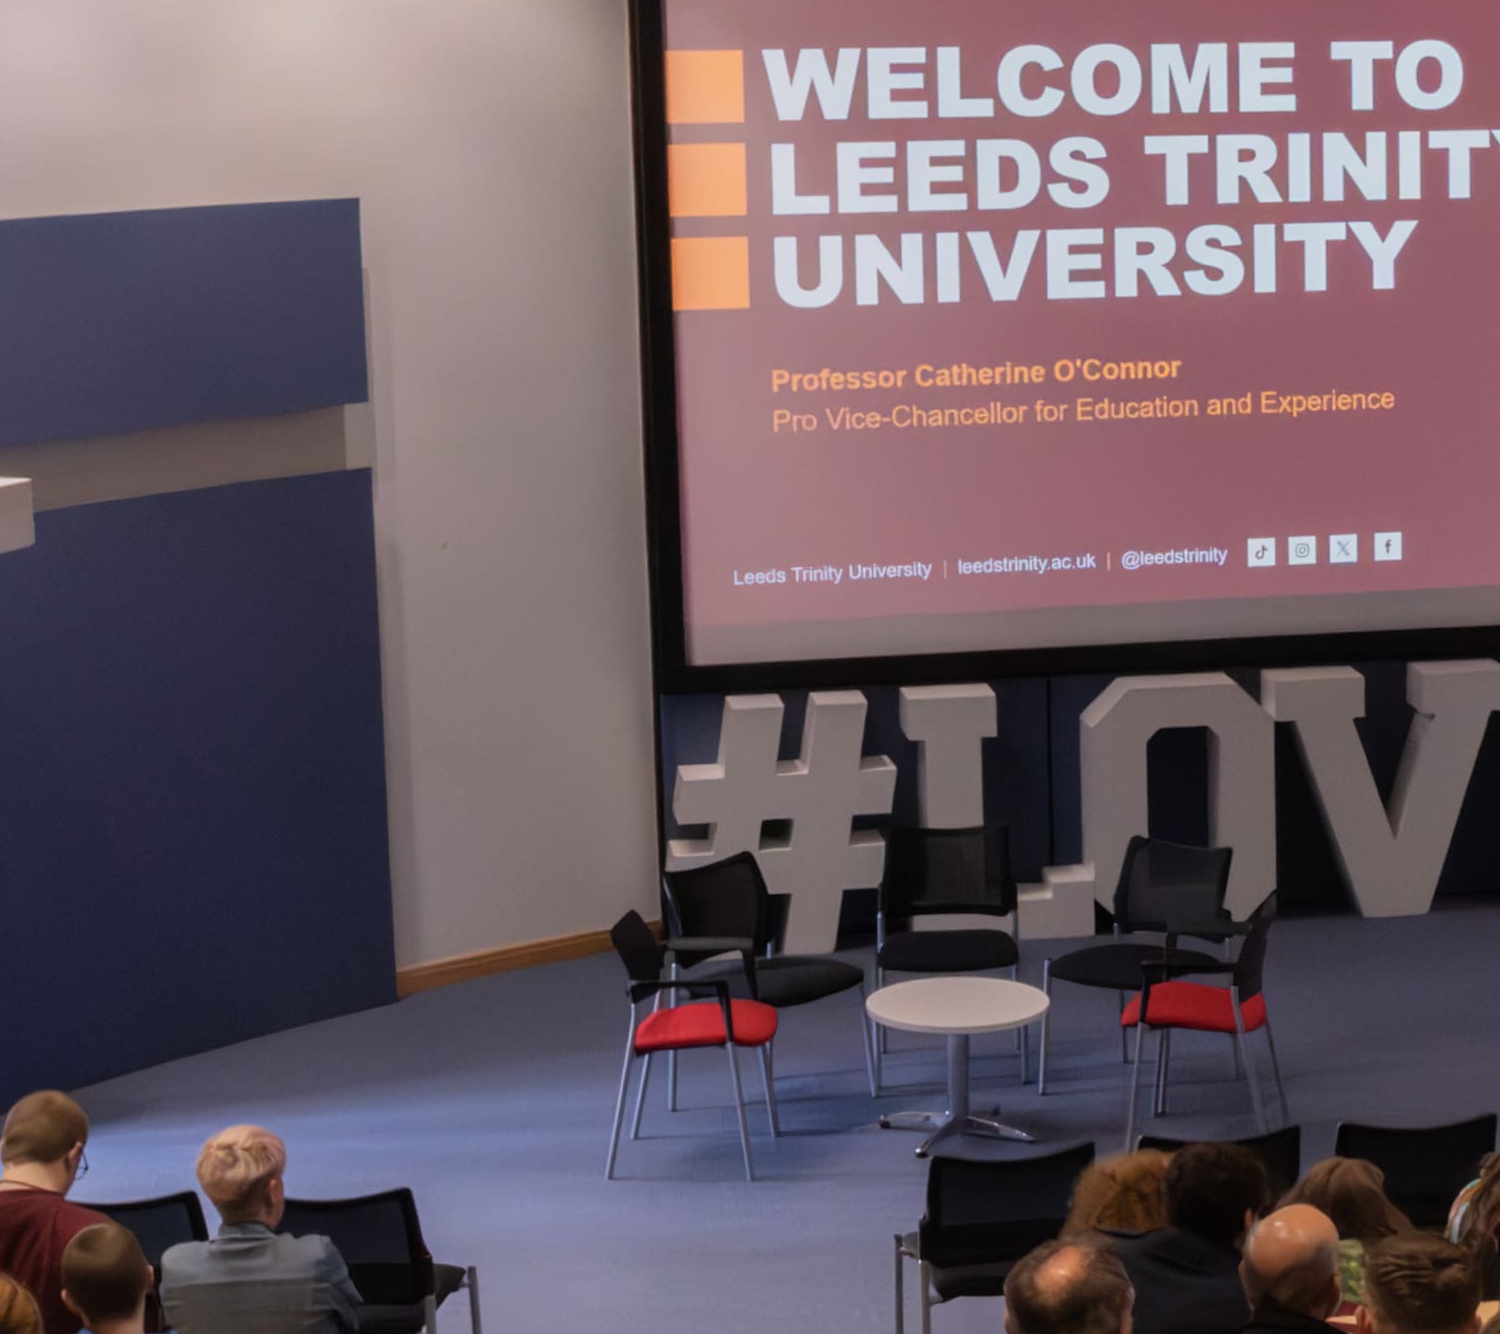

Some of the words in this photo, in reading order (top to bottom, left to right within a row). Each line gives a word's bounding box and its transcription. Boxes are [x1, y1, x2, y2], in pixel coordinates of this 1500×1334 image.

[761, 42, 1297, 122] WELCOME
[1330, 40, 1464, 111] TO
[771, 136, 1111, 216] LEEDS
[773, 220, 1419, 309] UNIVERSITY
[772, 367, 907, 393] Professor
[915, 361, 1046, 388] Catherine
[1054, 359, 1182, 383] O'Connor
[773, 409, 818, 433] Pro
[825, 400, 1028, 431] Vice-Chancellor
[1034, 400, 1068, 422] for
[1076, 396, 1199, 421] Education
[1207, 392, 1252, 416] and
[1260, 389, 1396, 418] Experience
[733, 569, 787, 586] Leeds
[791, 565, 843, 585] Trinity
[849, 561, 933, 581] University
[958, 552, 1096, 575] leedstrinity.ac.uk
[1121, 547, 1228, 570] @leedstrinity
